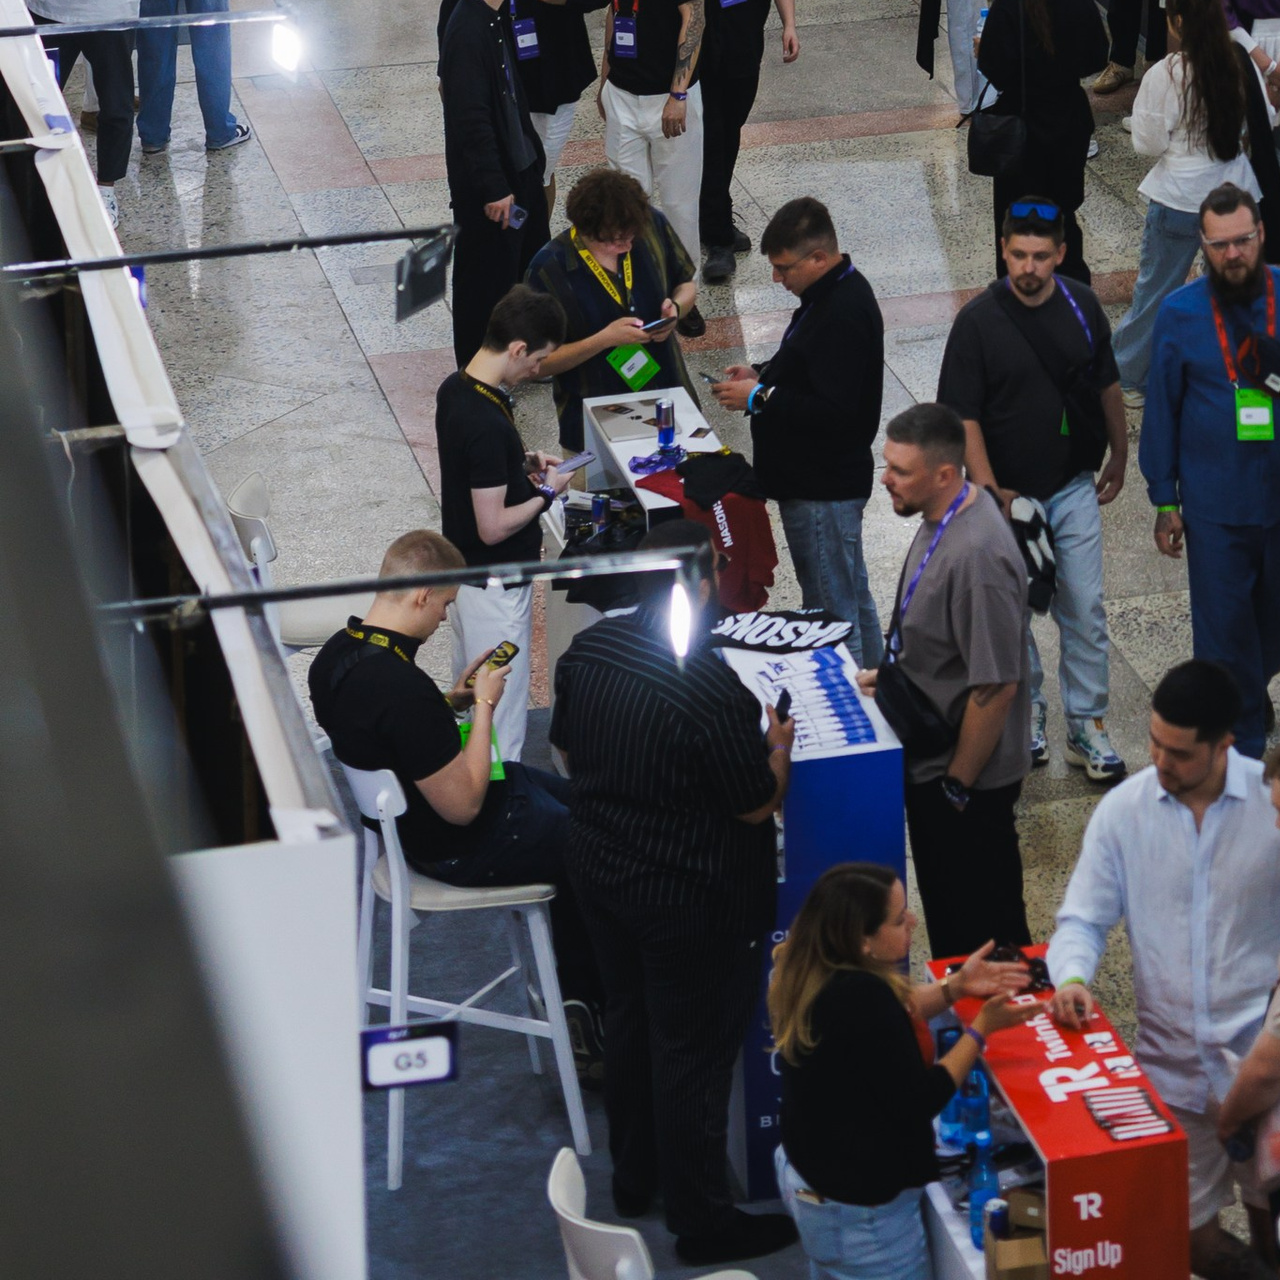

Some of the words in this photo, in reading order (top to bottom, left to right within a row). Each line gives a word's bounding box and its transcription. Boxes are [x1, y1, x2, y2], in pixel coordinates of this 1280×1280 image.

[713, 501, 733, 548] MASON
[394, 1050, 428, 1071] G5
[1054, 1246, 1095, 1276] Sign
[1097, 1241, 1122, 1268] Up
